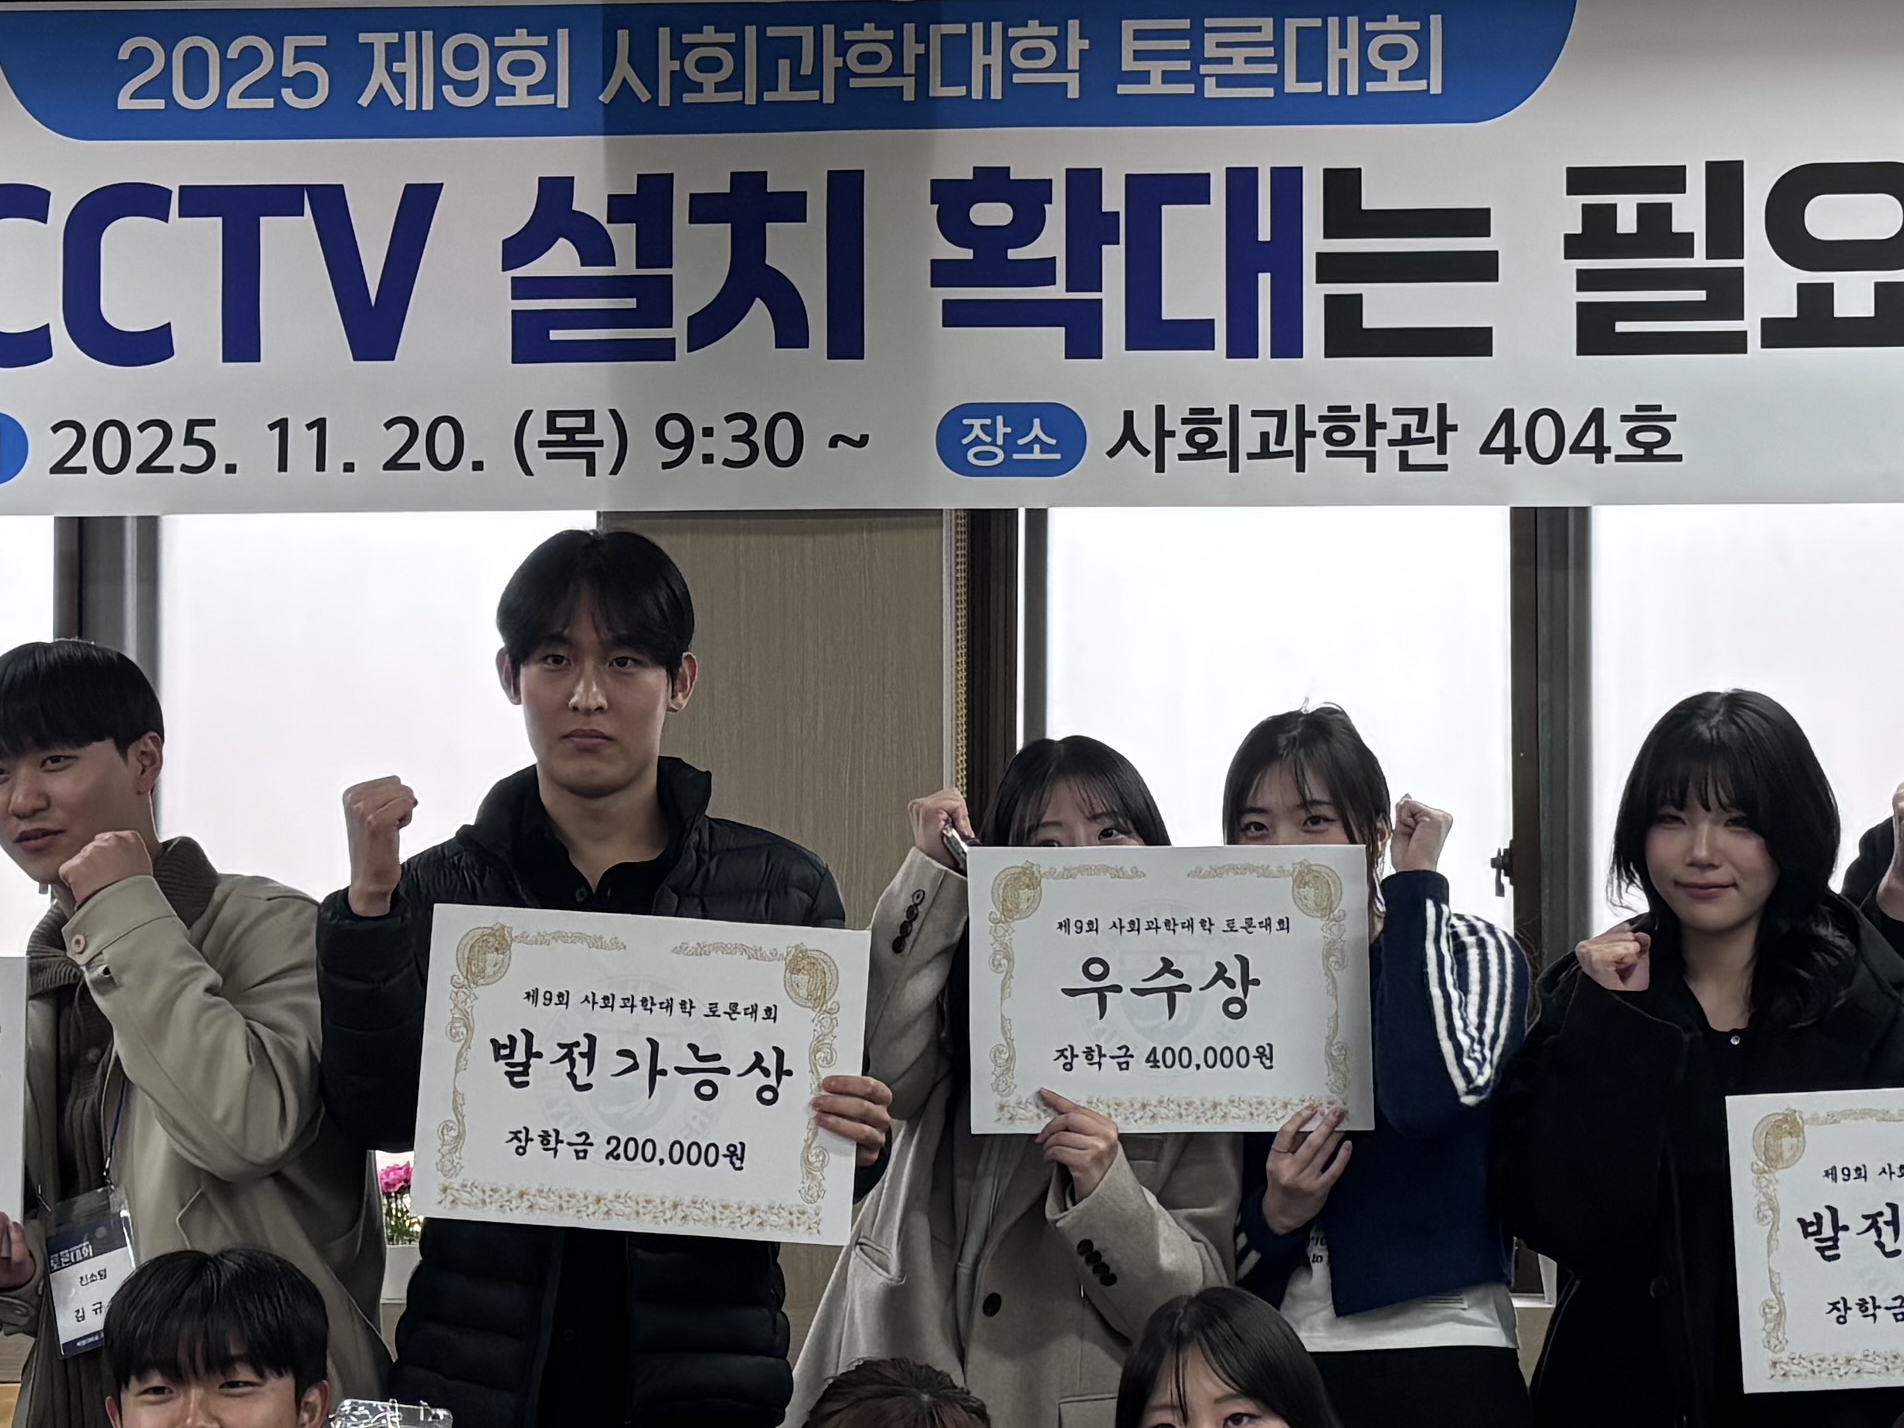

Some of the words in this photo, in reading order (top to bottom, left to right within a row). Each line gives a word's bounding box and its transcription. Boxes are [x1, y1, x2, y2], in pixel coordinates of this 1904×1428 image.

[118, 36, 329, 109] 2025
[358, 29, 568, 110] 제9회
[598, 19, 1089, 106] 사회과학대학
[1117, 15, 1442, 98] 토론대회
[502, 169, 864, 364] 설치
[930, 166, 1498, 359] 확대는
[50, 419, 237, 475] 2025.
[268, 418, 354, 472] 11.
[383, 416, 484, 471] 20.
[515, 409, 627, 477] (목)
[656, 412, 804, 470] 9:30
[829, 434, 869, 448] ~
[962, 416, 1061, 466] 장소
[1106, 403, 1458, 473] 사회과학관
[1479, 405, 1682, 465] 404호
[1057, 918, 1098, 935] 제9회
[1109, 917, 1215, 935] 사회과학대학
[1222, 917, 1289, 934] 토론대회
[524, 988, 569, 1009] 제9회
[581, 992, 696, 1017] 사회과학대학
[703, 1002, 777, 1023] 토론대회
[1061, 954, 1260, 1020] 우수상
[490, 1028, 793, 1106] 발전가능상
[1054, 1044, 1134, 1071] 장학금
[1145, 1043, 1273, 1070] 400,000원
[506, 1126, 594, 1160] 장학금
[605, 1136, 745, 1171] 200,000원
[1823, 1164, 1867, 1183] 제9회
